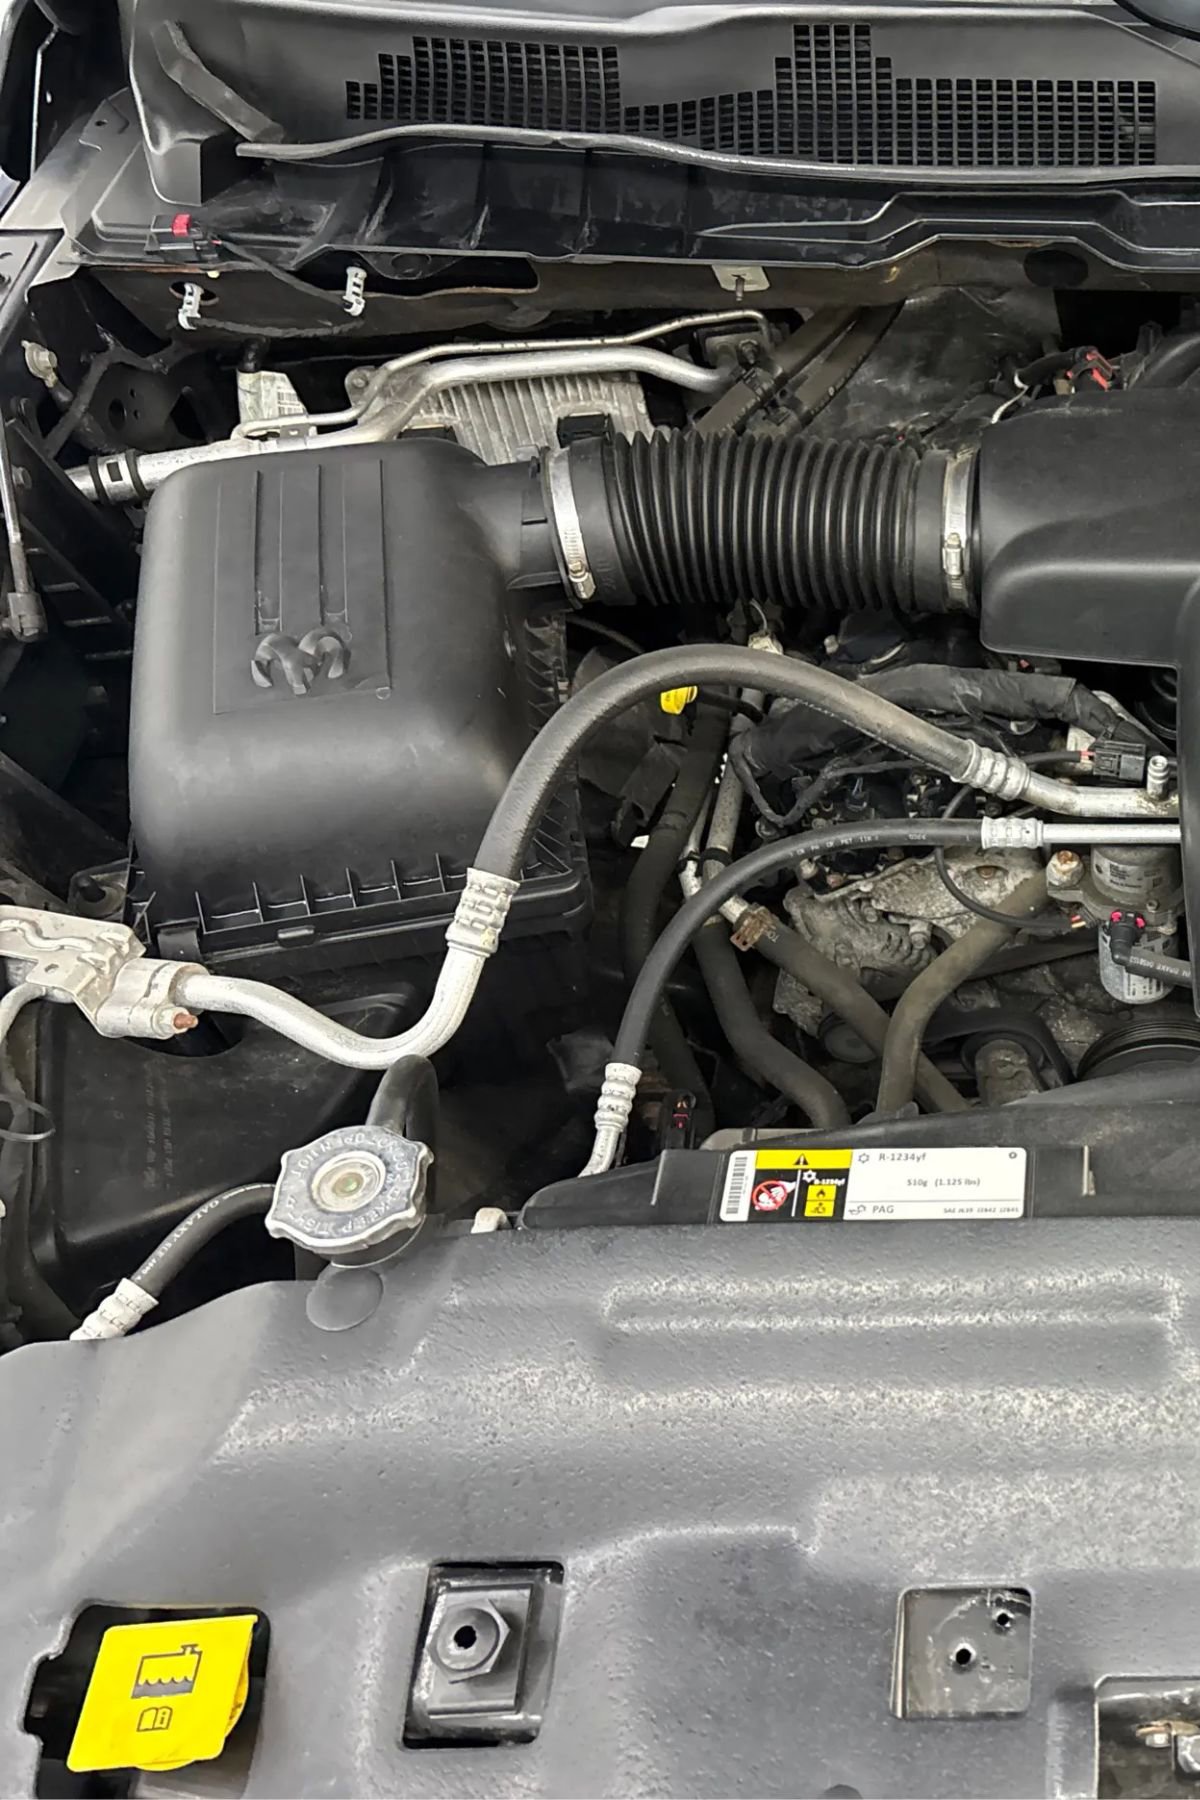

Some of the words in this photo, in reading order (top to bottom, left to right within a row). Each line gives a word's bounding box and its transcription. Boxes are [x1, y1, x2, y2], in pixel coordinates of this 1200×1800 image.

[878, 1152, 927, 1163] R-1234yf
[906, 1178, 928, 1188] 510g
[872, 1205, 895, 1214] PAG
